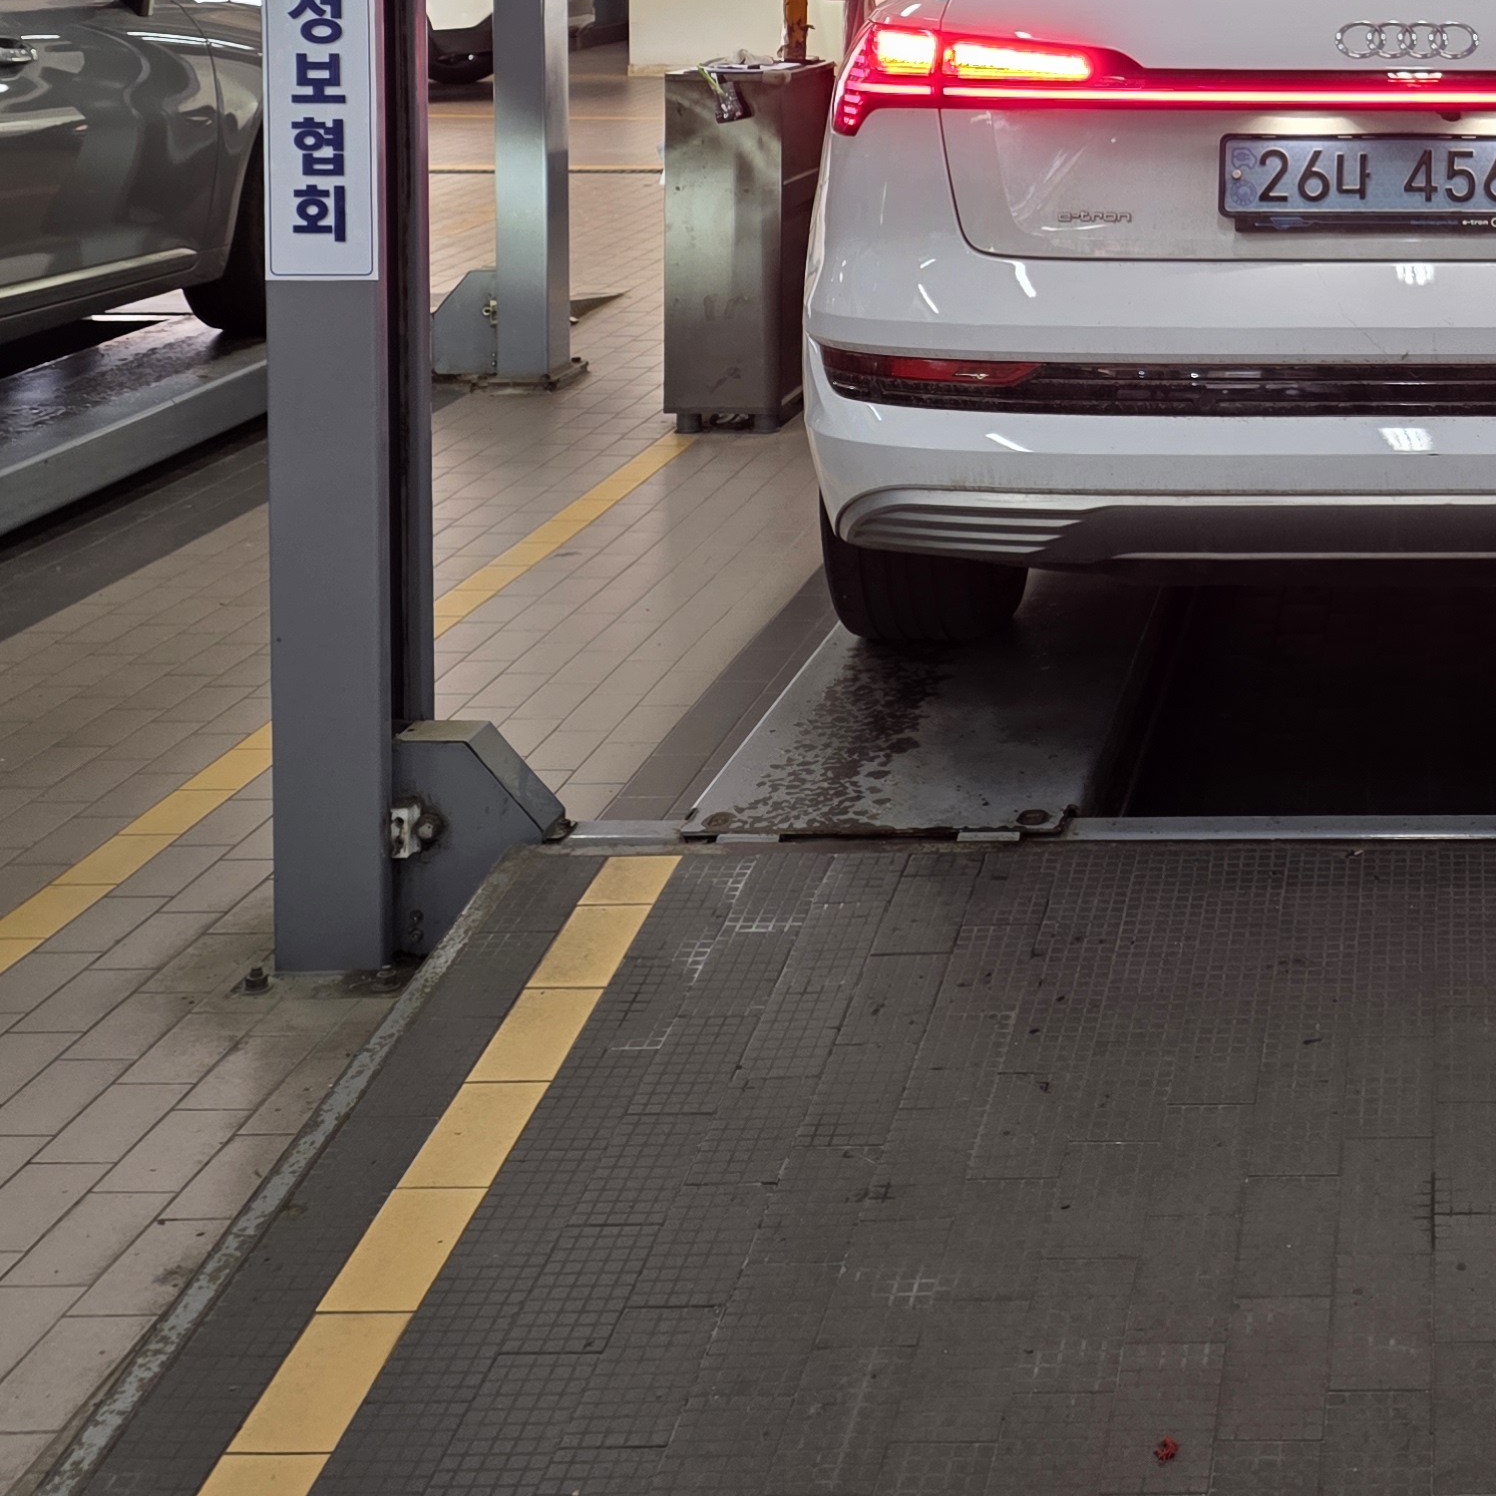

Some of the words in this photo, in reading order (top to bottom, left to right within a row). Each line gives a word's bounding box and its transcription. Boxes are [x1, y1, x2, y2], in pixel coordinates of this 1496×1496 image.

[1258, 148, 1371, 203] 26나
[1058, 209, 1133, 224] e-tron
[1462, 218, 1489, 226] e-tron
